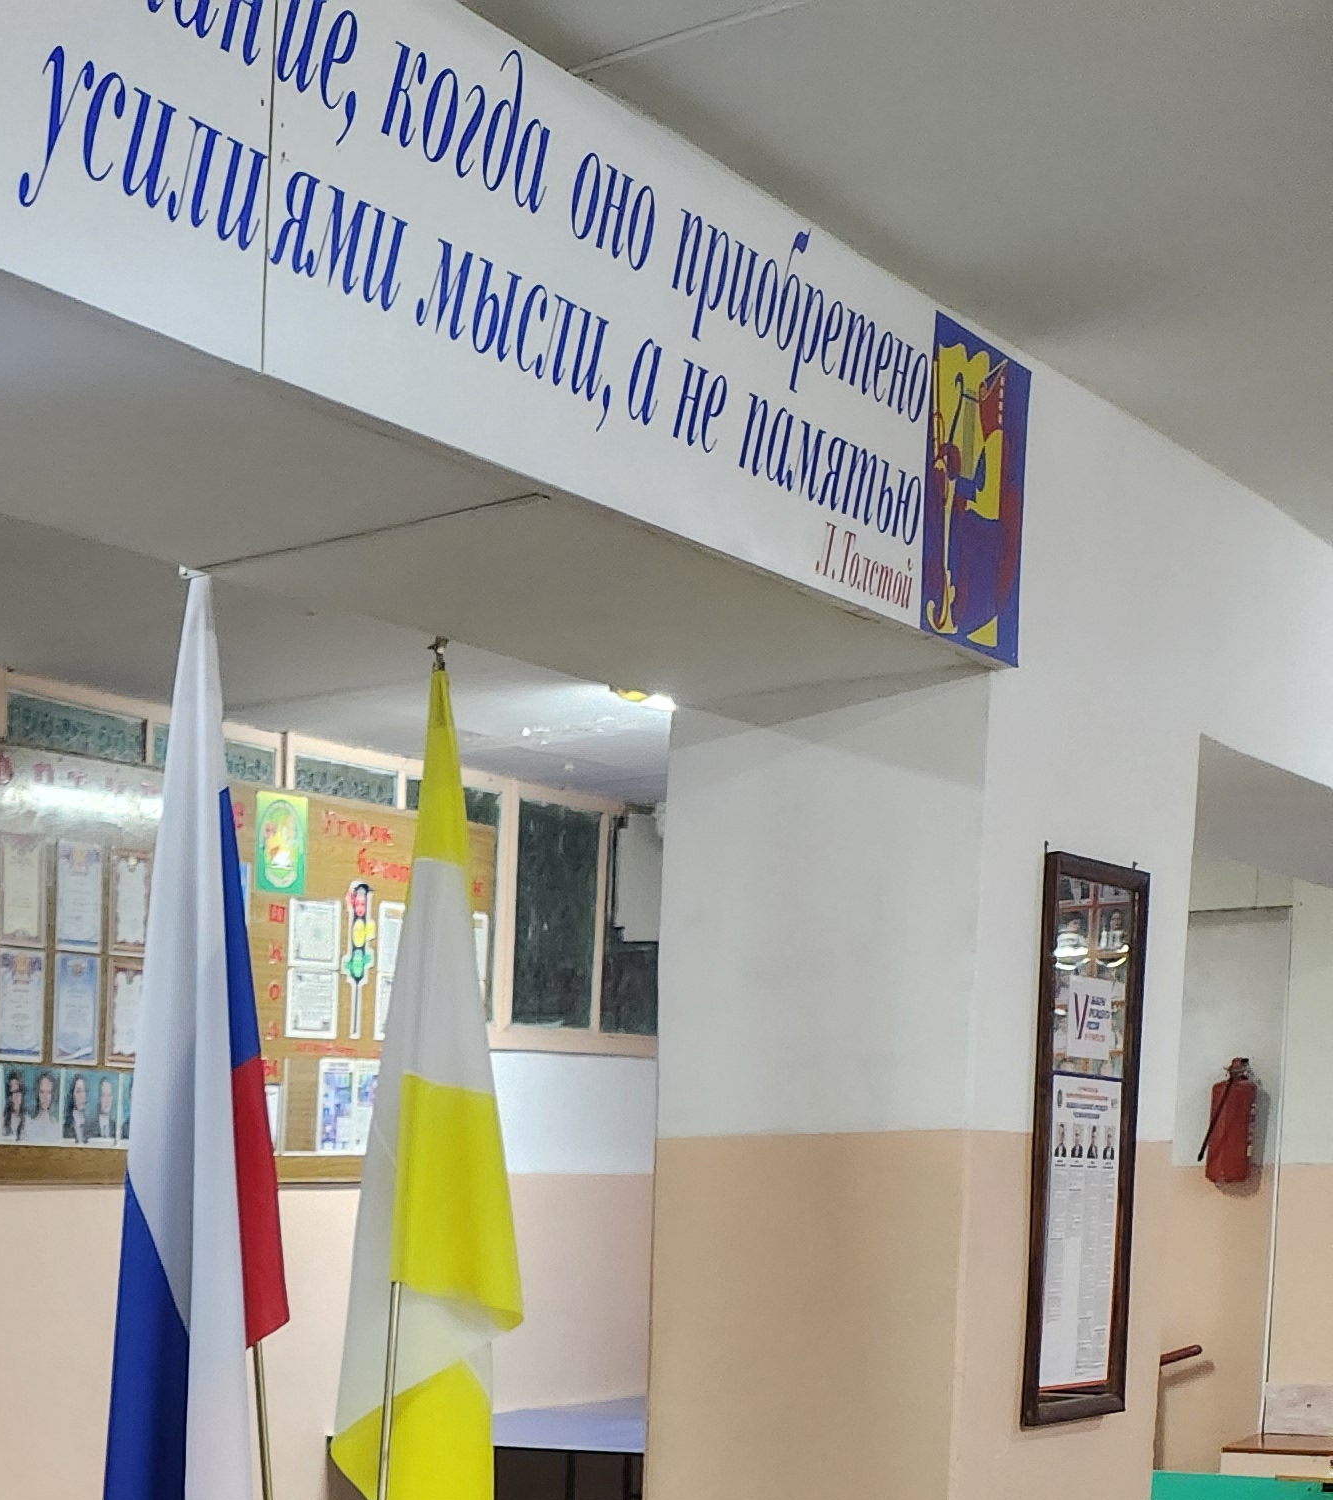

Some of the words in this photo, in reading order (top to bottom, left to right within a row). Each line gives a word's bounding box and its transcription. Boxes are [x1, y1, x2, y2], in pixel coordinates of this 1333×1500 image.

[19, 45, 408, 312] усилиями
[415, 238, 612, 432] мысли,
[628, 337, 663, 426] а
[672, 358, 728, 454] не
[738, 392, 922, 546] памятью
[380, 40, 551, 214] когда
[571, 152, 656, 271] оно
[671, 208, 929, 424] приобретено
